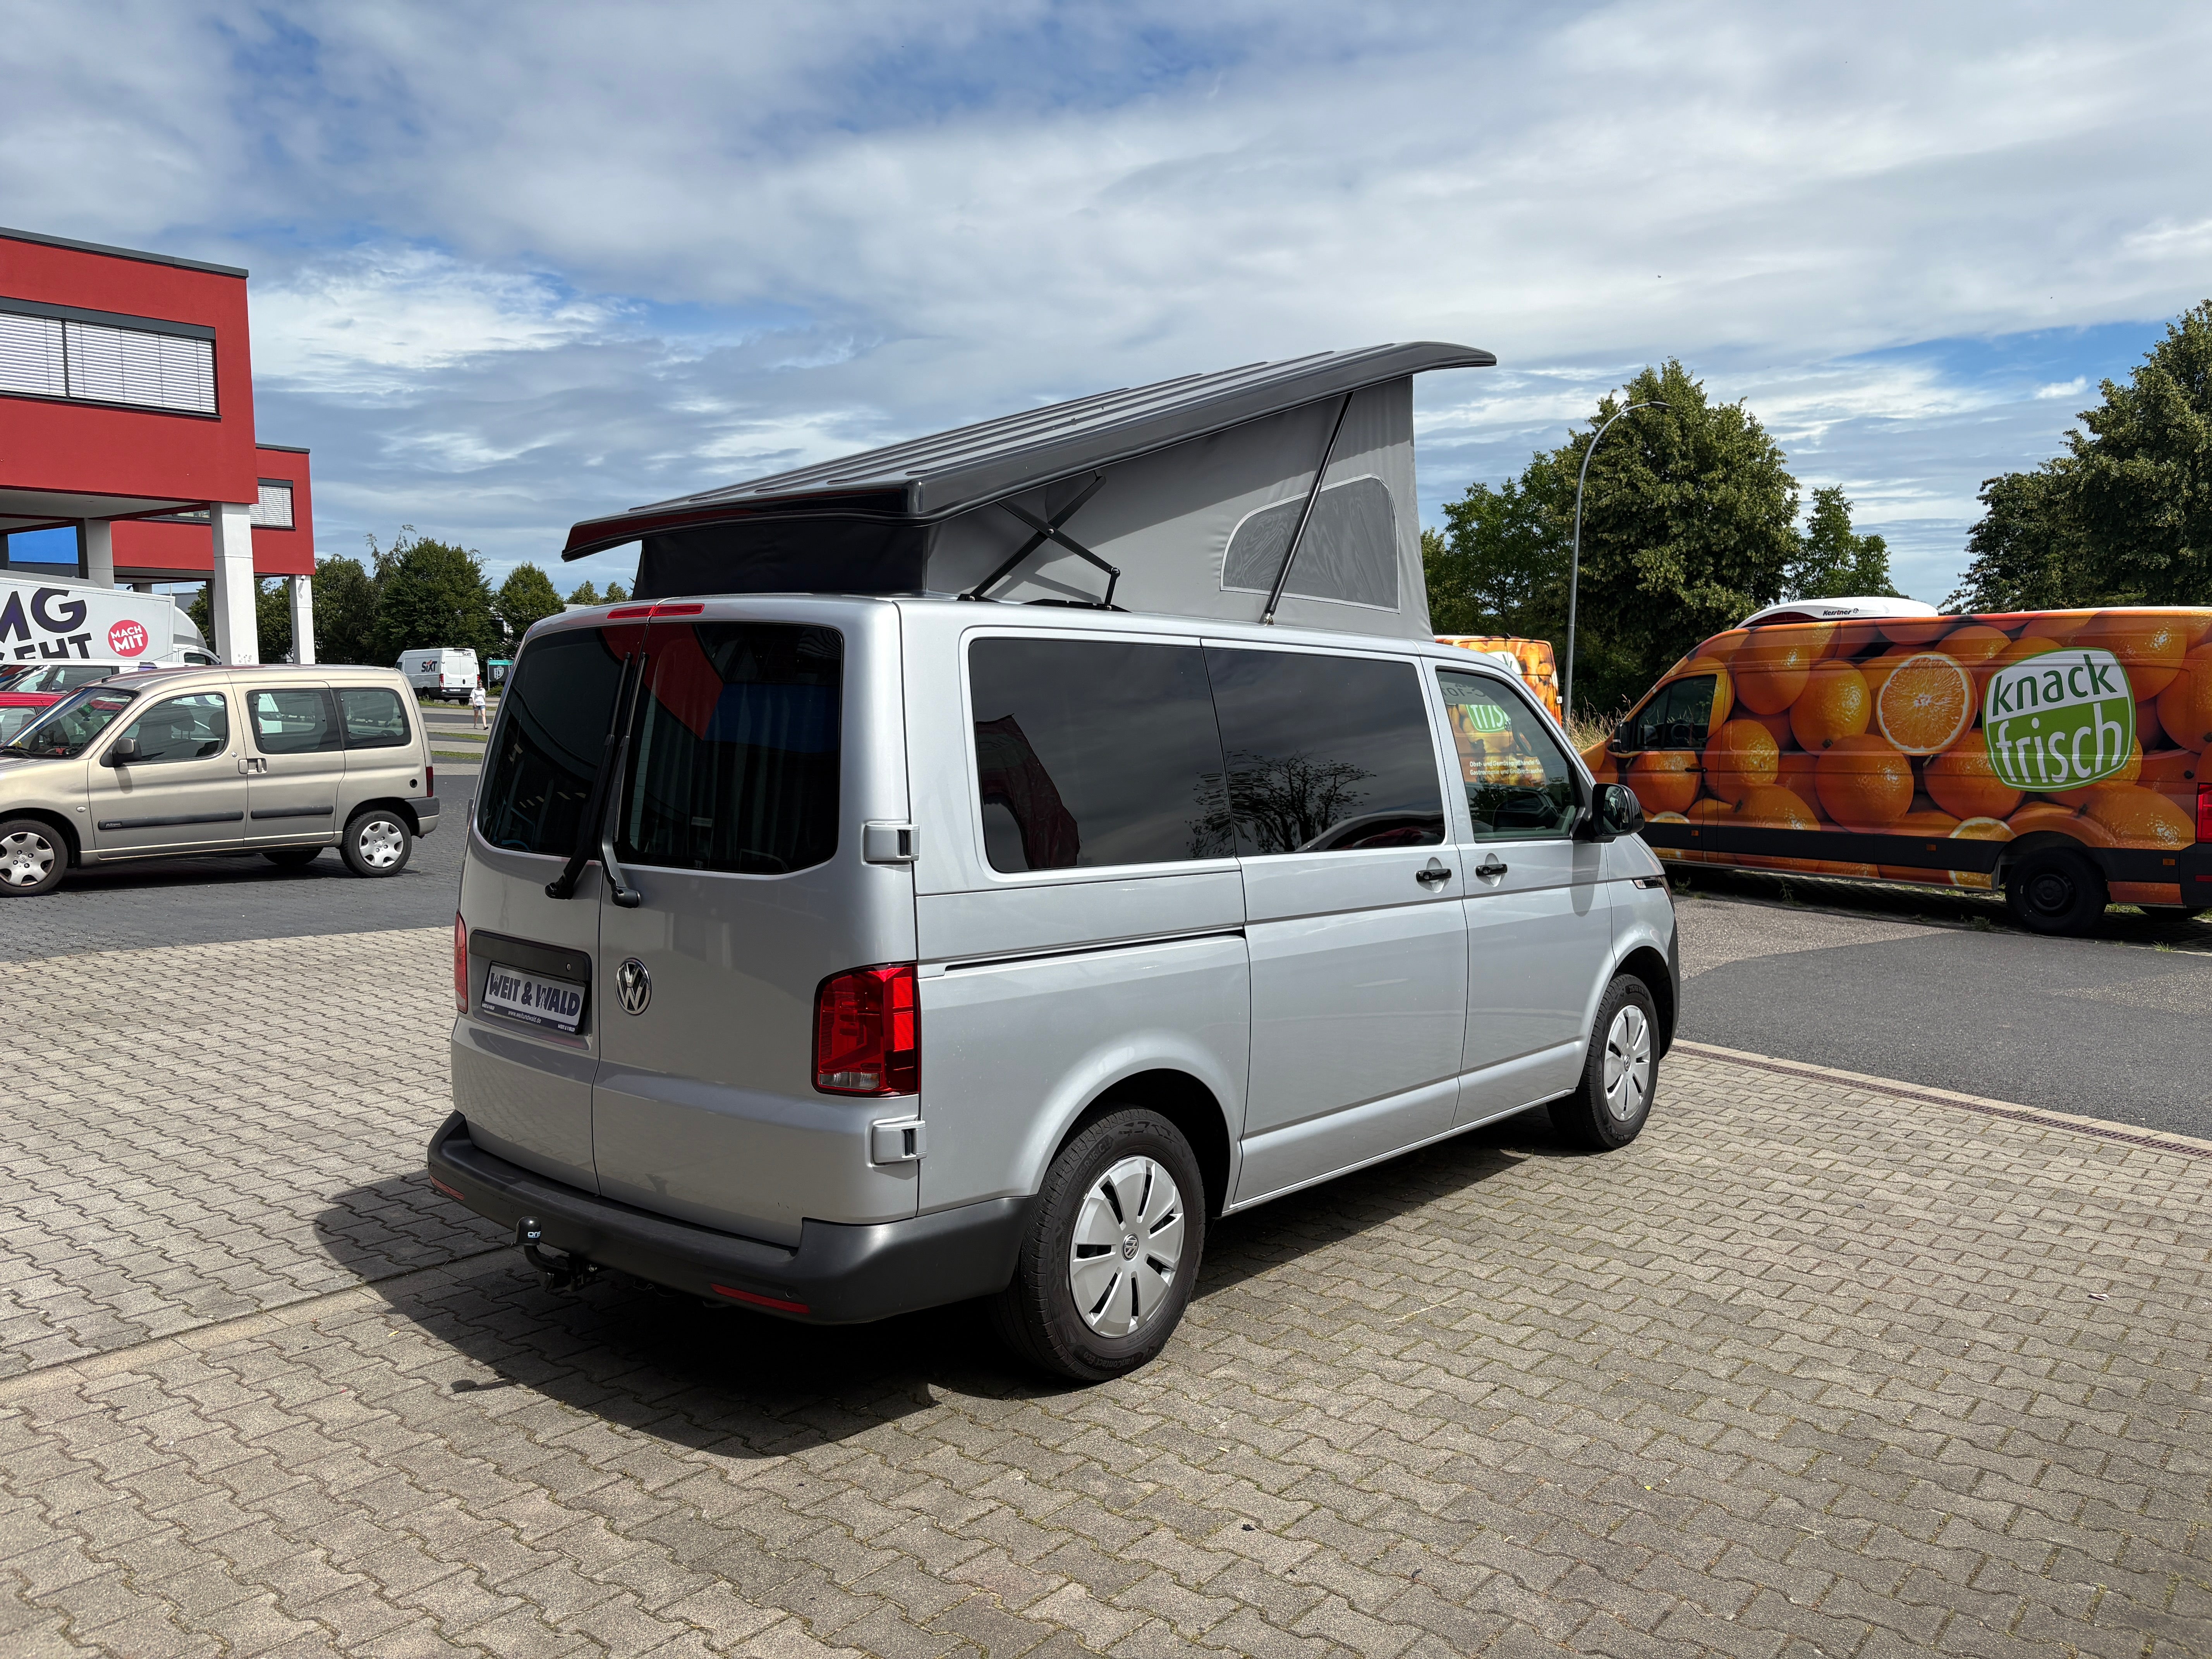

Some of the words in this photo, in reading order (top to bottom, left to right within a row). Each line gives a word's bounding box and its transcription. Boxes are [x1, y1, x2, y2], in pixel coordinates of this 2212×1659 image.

[110, 625, 142, 639] MACH
[113, 634, 143, 652] MIT
[1992, 654, 2117, 716] knack
[1996, 703, 2123, 783] frisch
[489, 972, 520, 1002] WEIT
[521, 981, 532, 1006] &
[536, 984, 580, 1017] WALD
